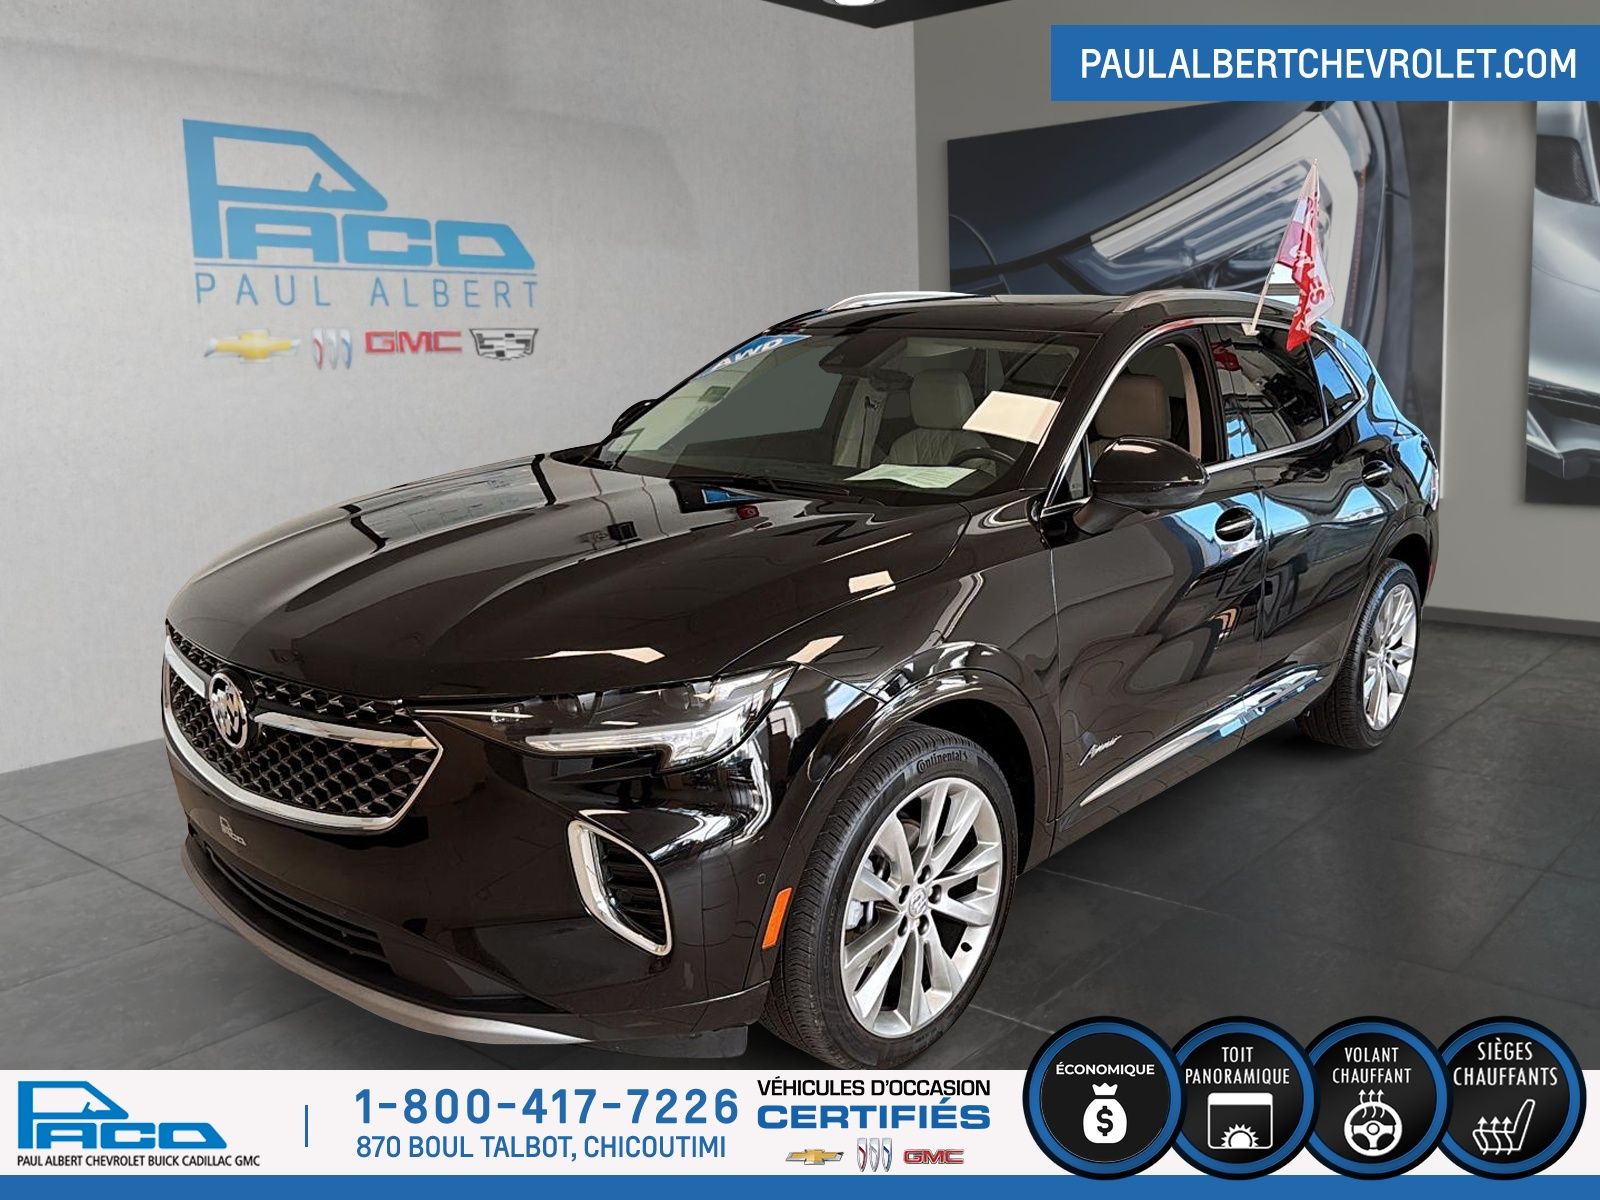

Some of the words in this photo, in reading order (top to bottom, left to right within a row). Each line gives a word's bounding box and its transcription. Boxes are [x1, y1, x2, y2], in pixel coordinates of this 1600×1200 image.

[194, 272, 331, 307] PAUL
[370, 276, 538, 308] ALBERT
[364, 330, 463, 354] GMC
[916, 749, 962, 774] Continental
